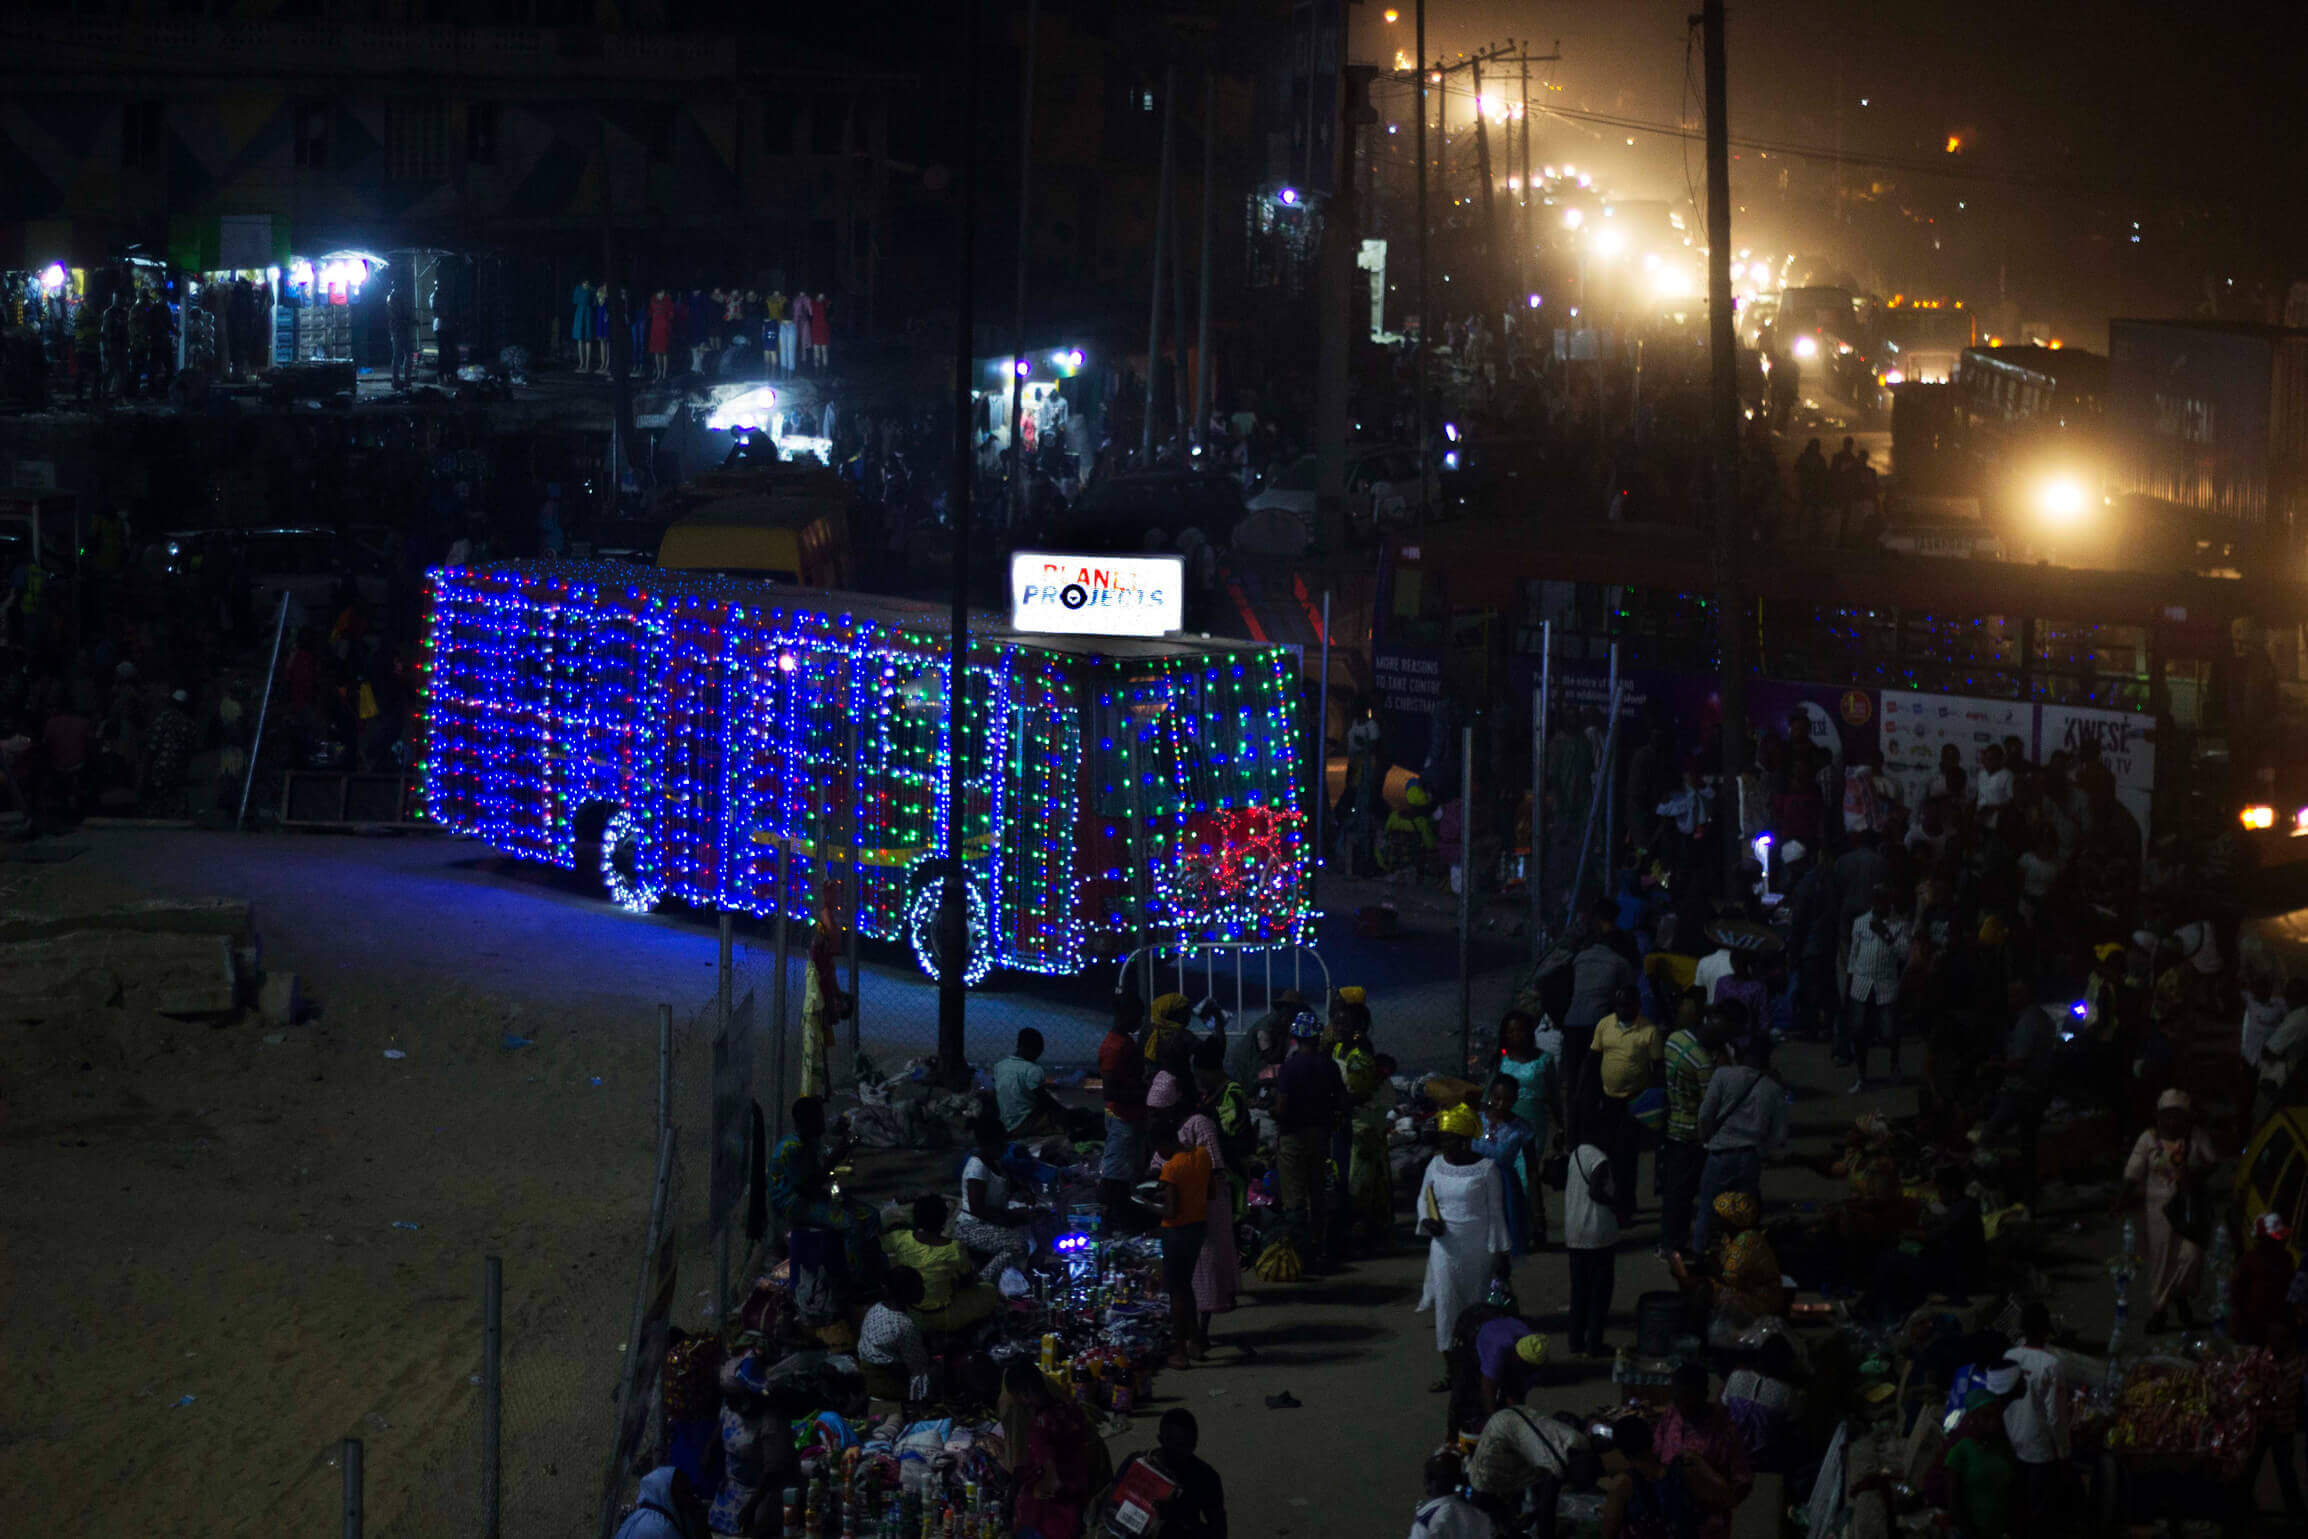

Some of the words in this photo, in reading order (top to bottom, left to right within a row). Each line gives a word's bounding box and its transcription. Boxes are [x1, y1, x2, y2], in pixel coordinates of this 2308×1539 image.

[1023, 584, 1164, 609] PROJECTS
[1401, 658, 1439, 675] REASONS
[1394, 696, 1440, 713] CHRISTMA
